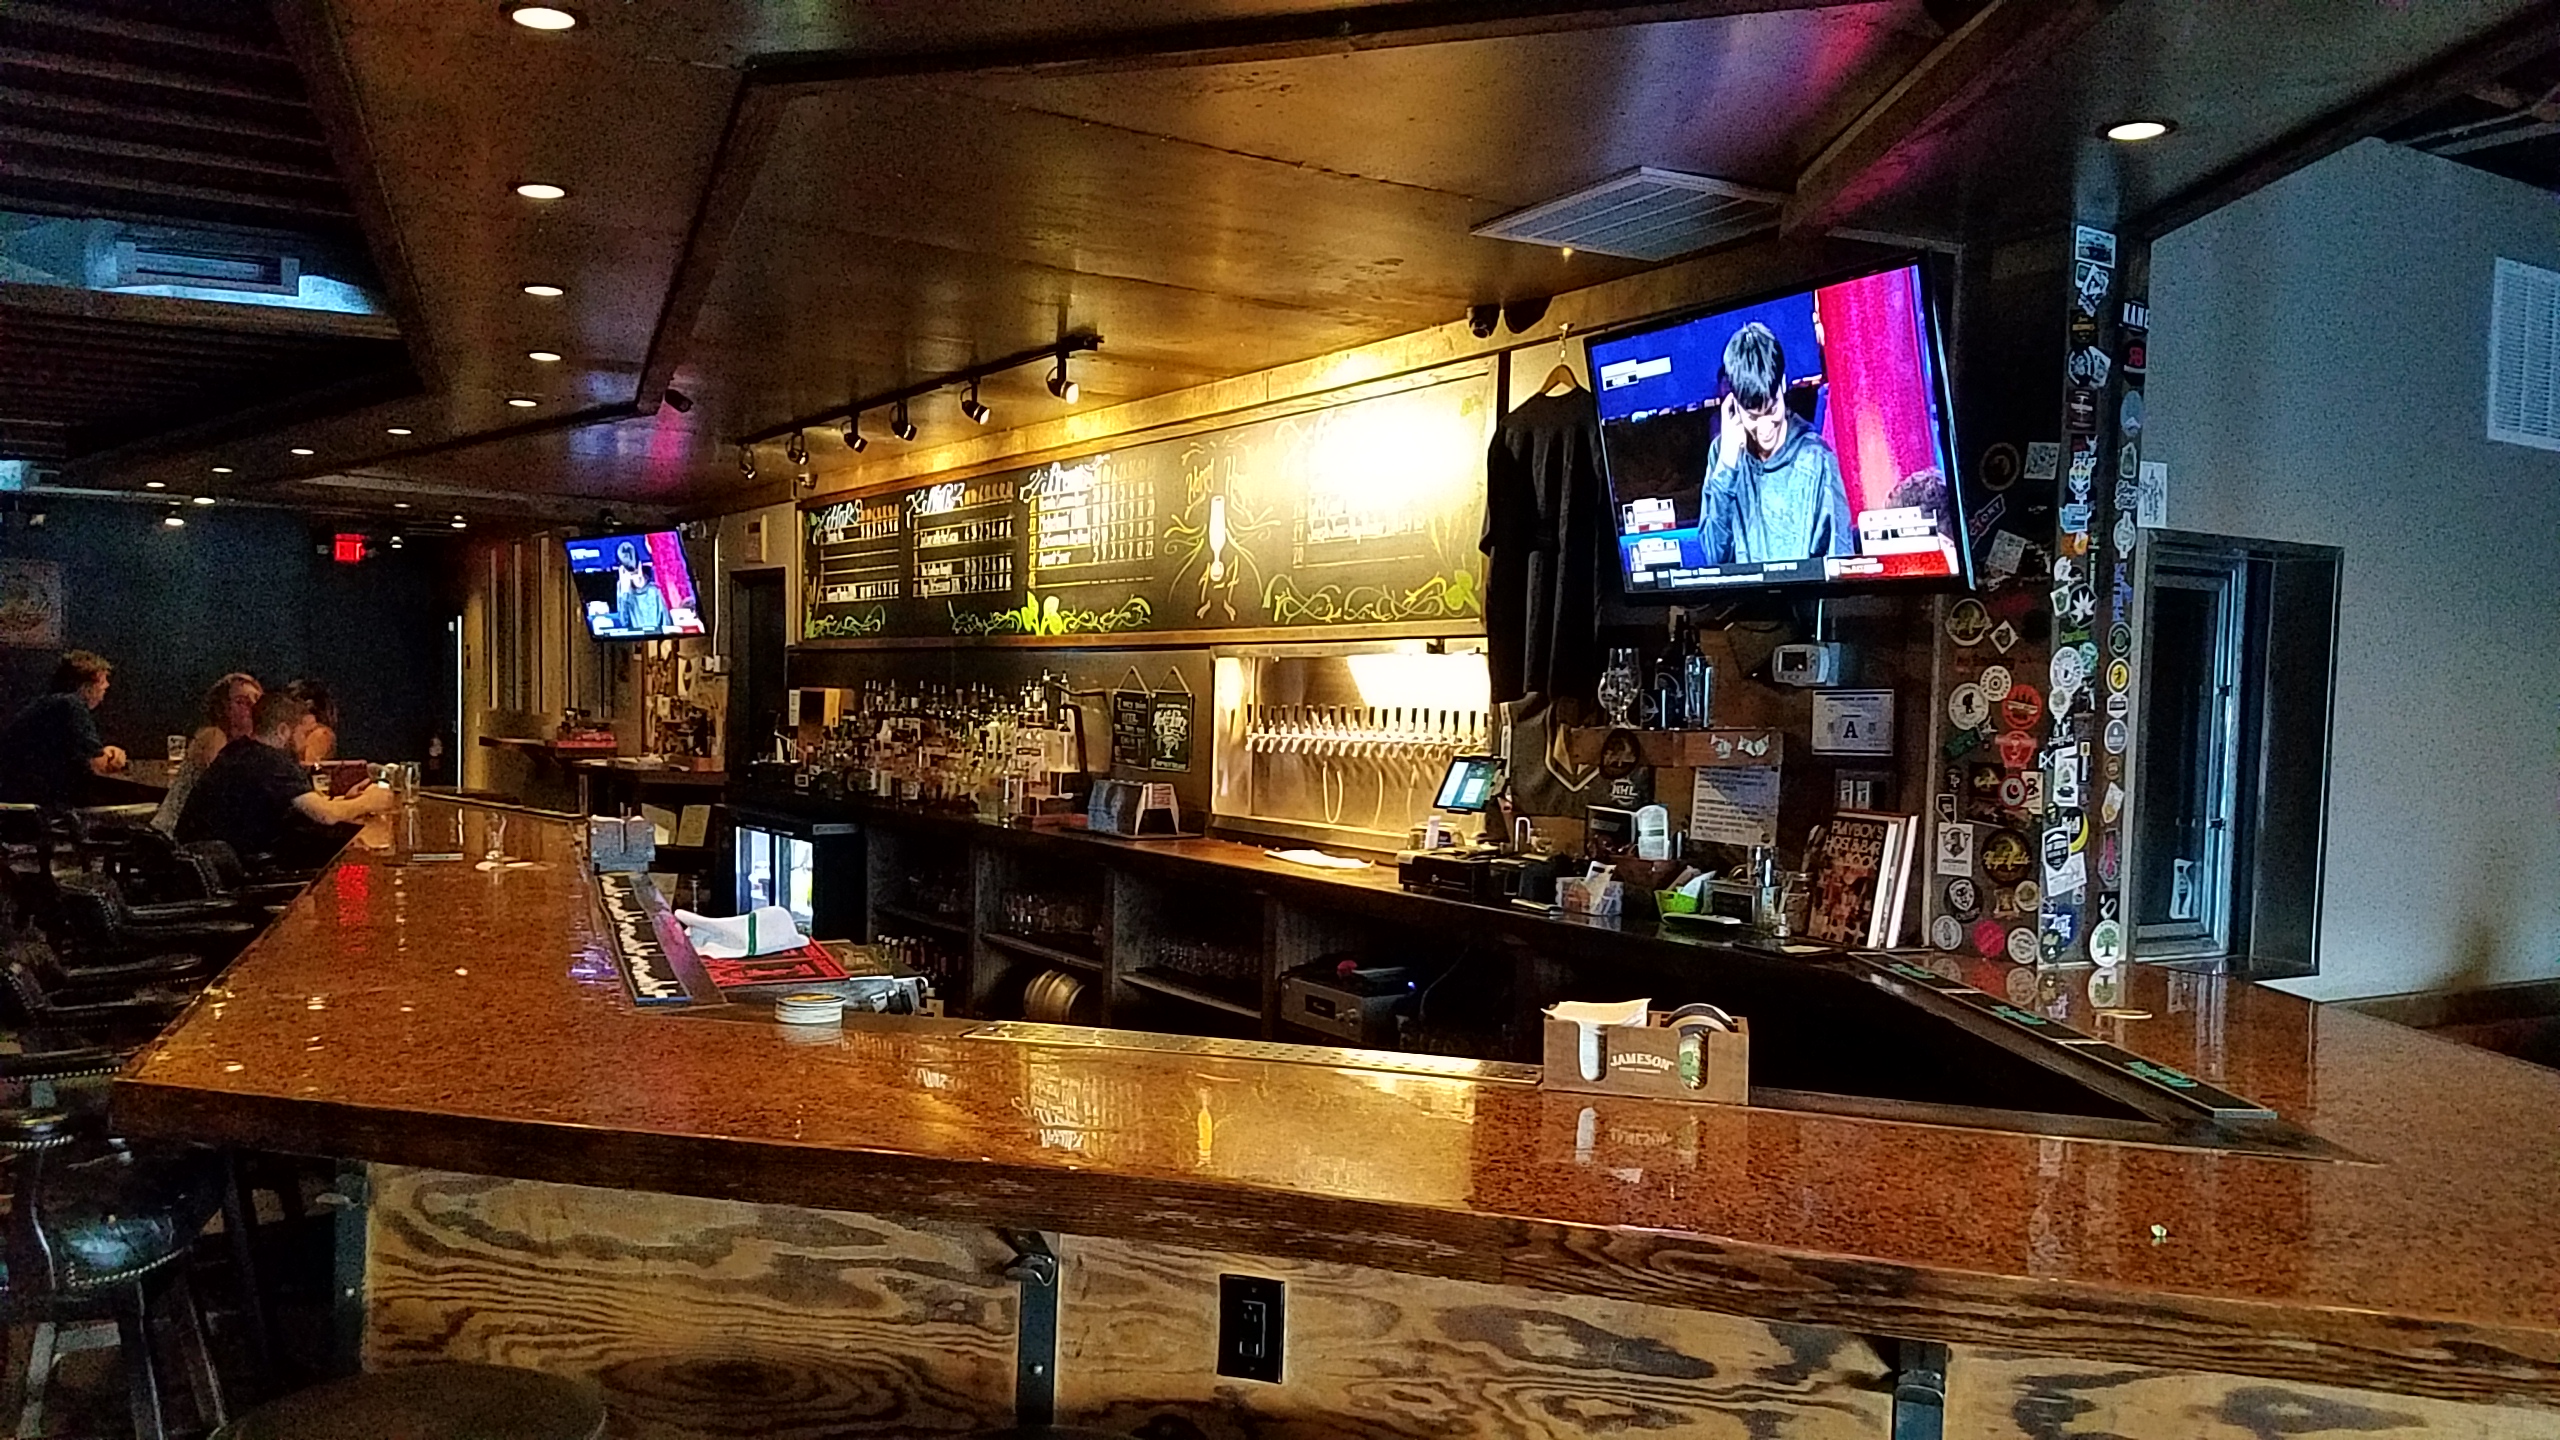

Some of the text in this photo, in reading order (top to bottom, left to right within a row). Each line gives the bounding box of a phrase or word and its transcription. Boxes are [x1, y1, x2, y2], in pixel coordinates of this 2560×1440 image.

[1843, 721, 1859, 738] A
[1612, 784, 1638, 796] NHL
[1610, 1053, 1674, 1071] JAMESON
